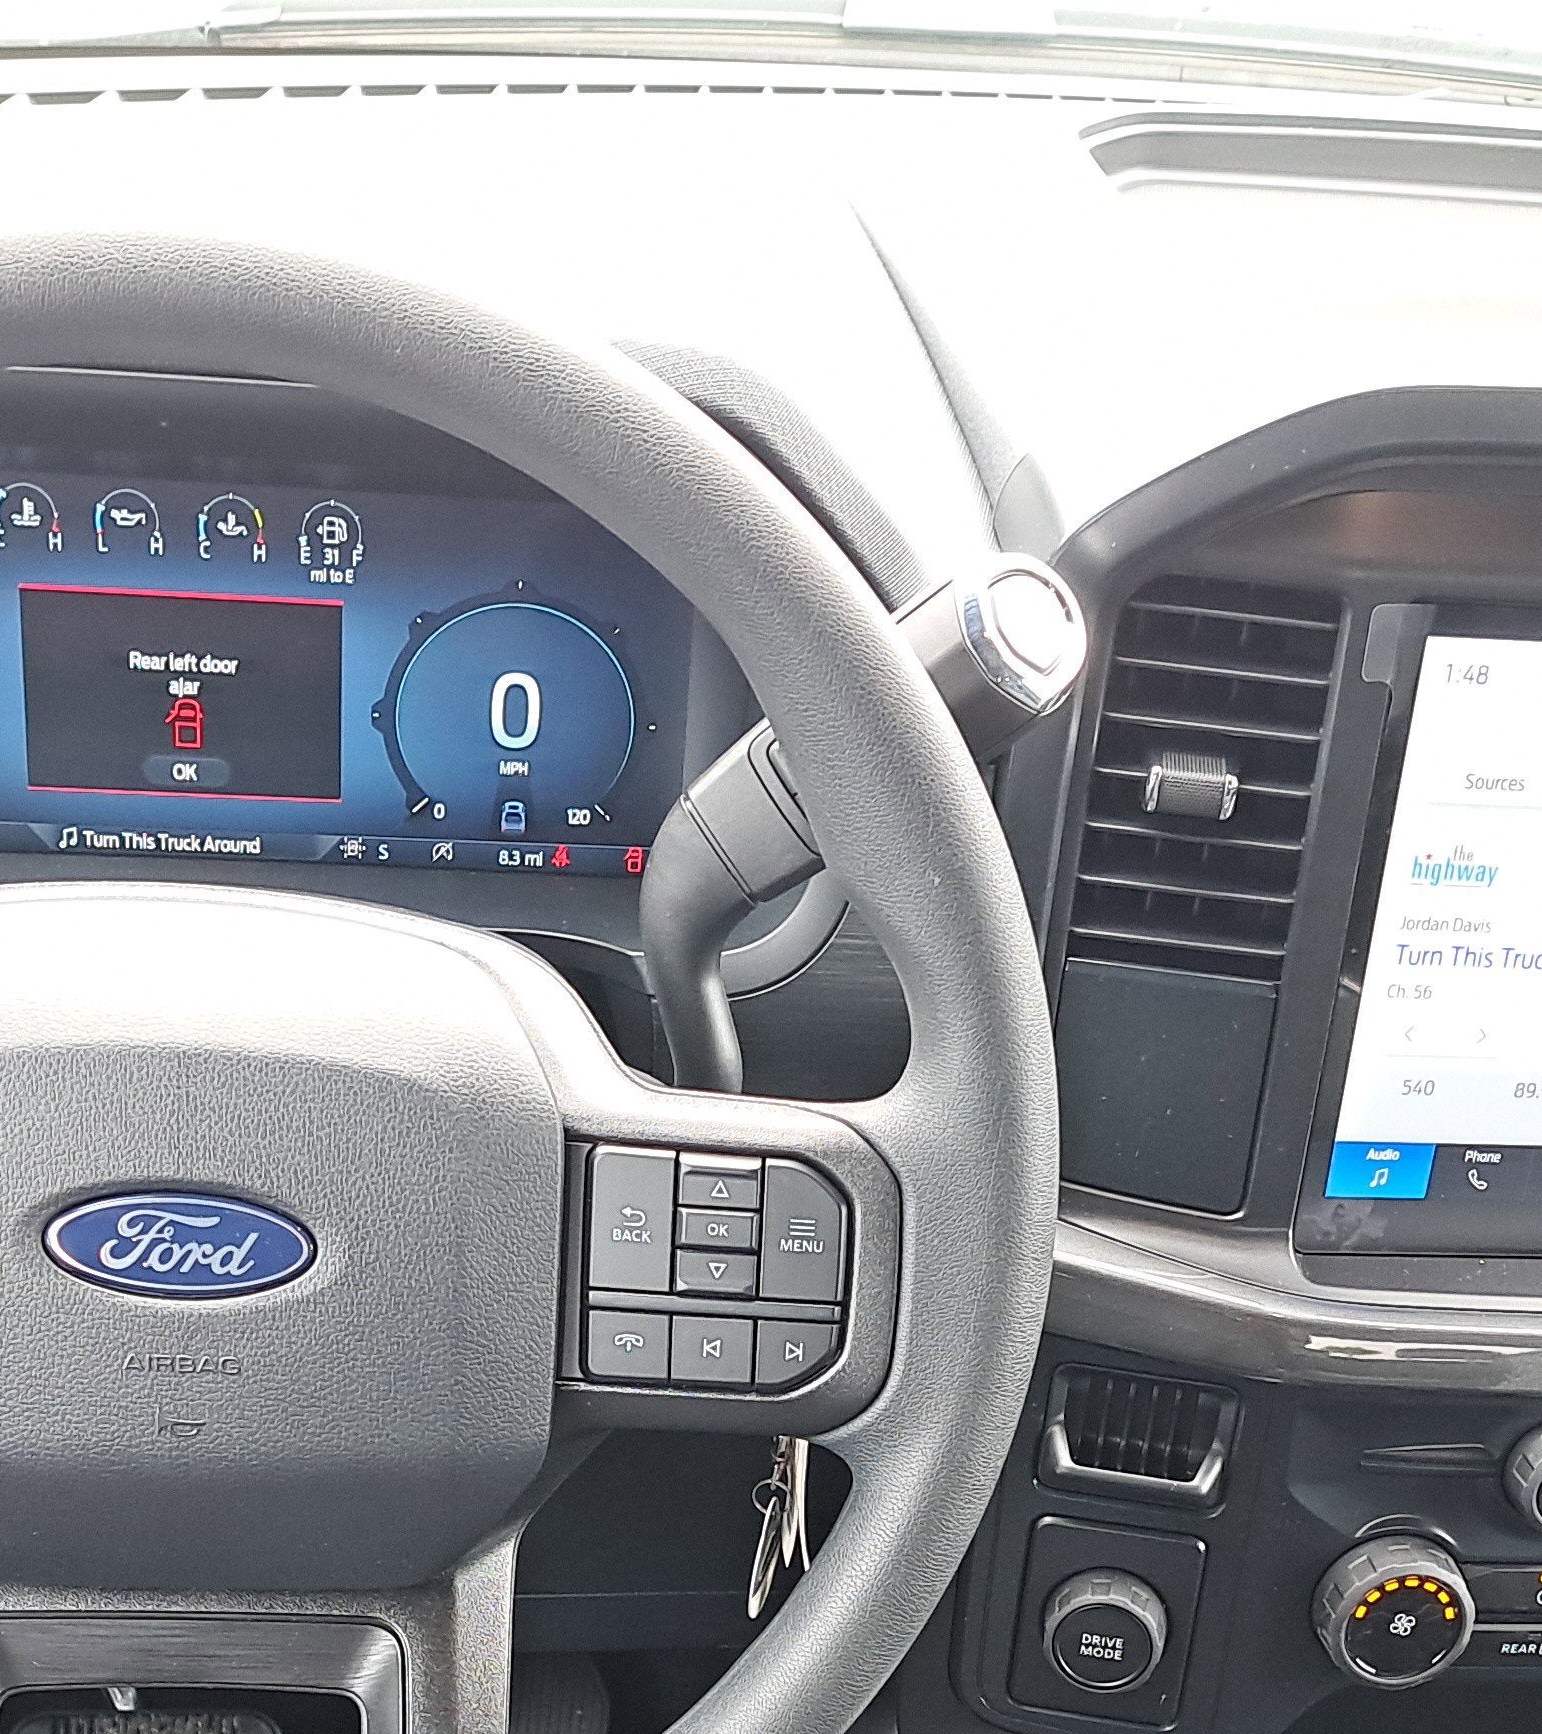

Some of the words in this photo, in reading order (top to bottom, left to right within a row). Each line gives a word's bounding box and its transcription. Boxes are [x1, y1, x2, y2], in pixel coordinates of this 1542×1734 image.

[48, 532, 62, 552] H
[98, 534, 108, 553] L
[150, 536, 163, 556] H
[199, 539, 210, 558] C
[253, 543, 266, 563] H
[300, 547, 311, 565] E
[323, 549, 339, 565] 31
[352, 550, 363, 567] F
[329, 569, 343, 583] to
[129, 651, 167, 671] Rear
[169, 652, 198, 673] left
[200, 654, 239, 675] door
[1445, 663, 1490, 686] 1:48
[168, 677, 200, 698] ajar
[488, 670, 542, 750] 0
[172, 763, 198, 781] OK
[499, 760, 529, 777] MPH
[1464, 773, 1525, 793] Sources
[433, 803, 445, 820] 0
[566, 808, 591, 826] 120
[82, 830, 120, 849] Turn
[122, 831, 156, 850] This
[158, 833, 201, 852] Truck
[203, 835, 261, 854] Around
[498, 850, 521, 866] 8.3
[1453, 844, 1474, 862] the
[1411, 854, 1499, 888] highway
[1400, 915, 1449, 931] Jordan
[1453, 917, 1492, 934] Davis
[1396, 944, 1443, 966] Turn
[1451, 945, 1494, 968] This
[1387, 983, 1409, 999] Ch.
[1414, 985, 1433, 1000] 56
[1401, 1079, 1436, 1096] 540
[1365, 1147, 1401, 1162] Audio
[1464, 1149, 1502, 1164] Phone
[612, 1229, 652, 1244] BACK
[707, 1223, 729, 1238] OK
[100, 1208, 261, 1277] Ford
[779, 1238, 824, 1253] MENU
[122, 1352, 243, 1376] AIRBAG
[1081, 1632, 1125, 1650] DRIVE
[1500, 1642, 1537, 1655] REAR
[1079, 1644, 1123, 1661] MODE
